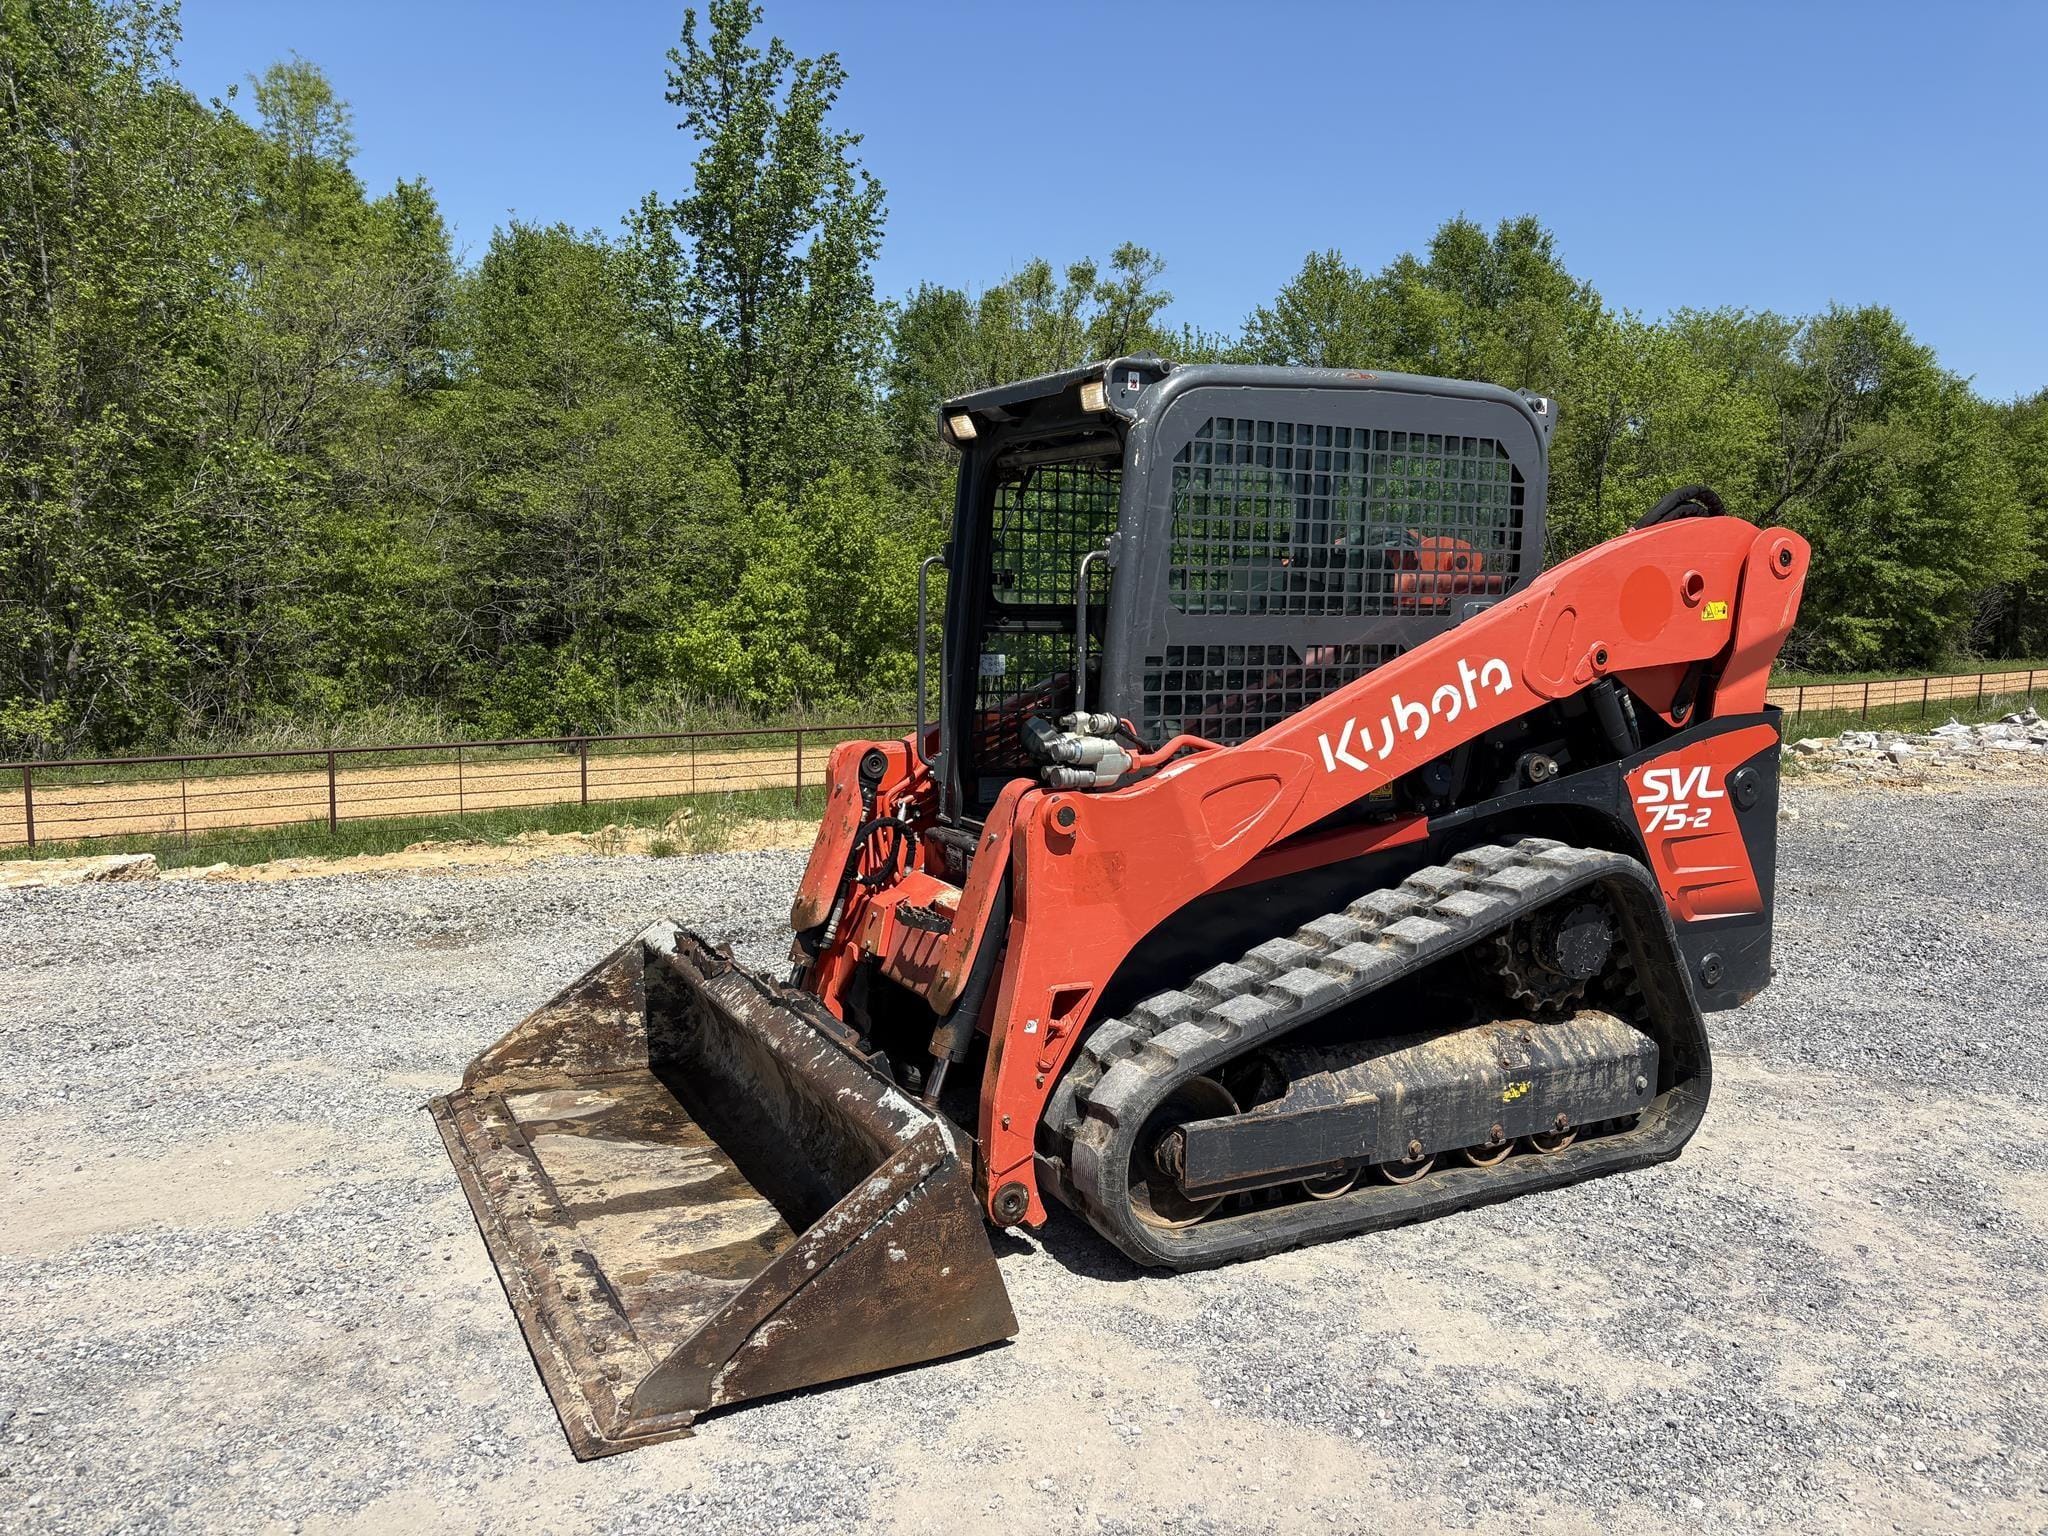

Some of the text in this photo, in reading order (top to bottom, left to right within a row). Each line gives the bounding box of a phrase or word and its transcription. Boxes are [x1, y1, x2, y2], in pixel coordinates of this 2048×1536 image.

[1317, 658, 1513, 773] Kubota
[1636, 765, 1725, 804] SVL
[1644, 803, 1712, 833] 75-2
